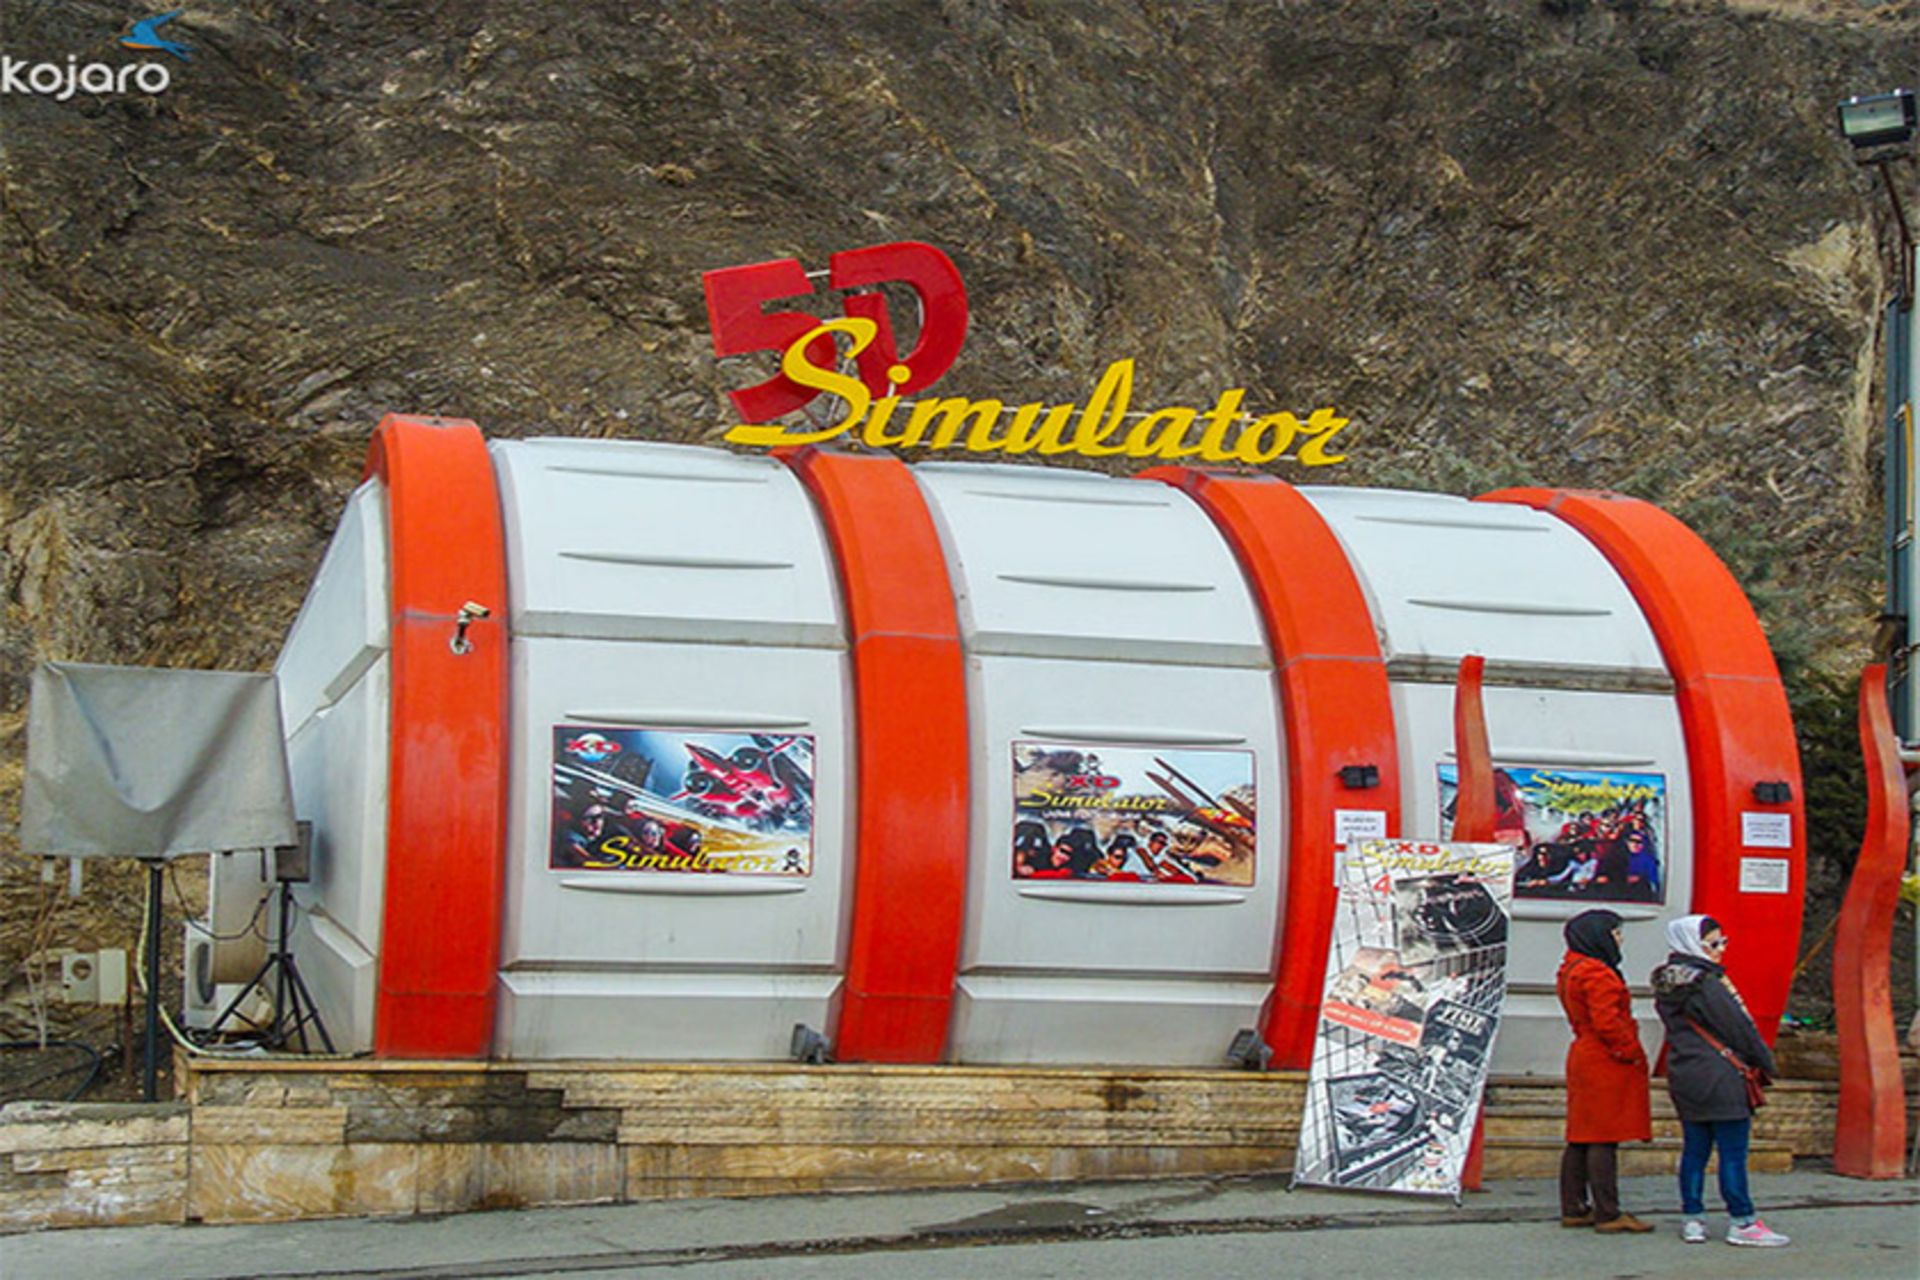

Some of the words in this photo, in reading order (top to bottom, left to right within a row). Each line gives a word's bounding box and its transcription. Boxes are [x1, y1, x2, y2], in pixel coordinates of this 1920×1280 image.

[702, 240, 969, 425] 5D
[723, 317, 1350, 467] Simulator
[1018, 781, 1168, 812] Simulator
[582, 835, 777, 871] Simulator
[1345, 839, 1512, 875] Simulator
